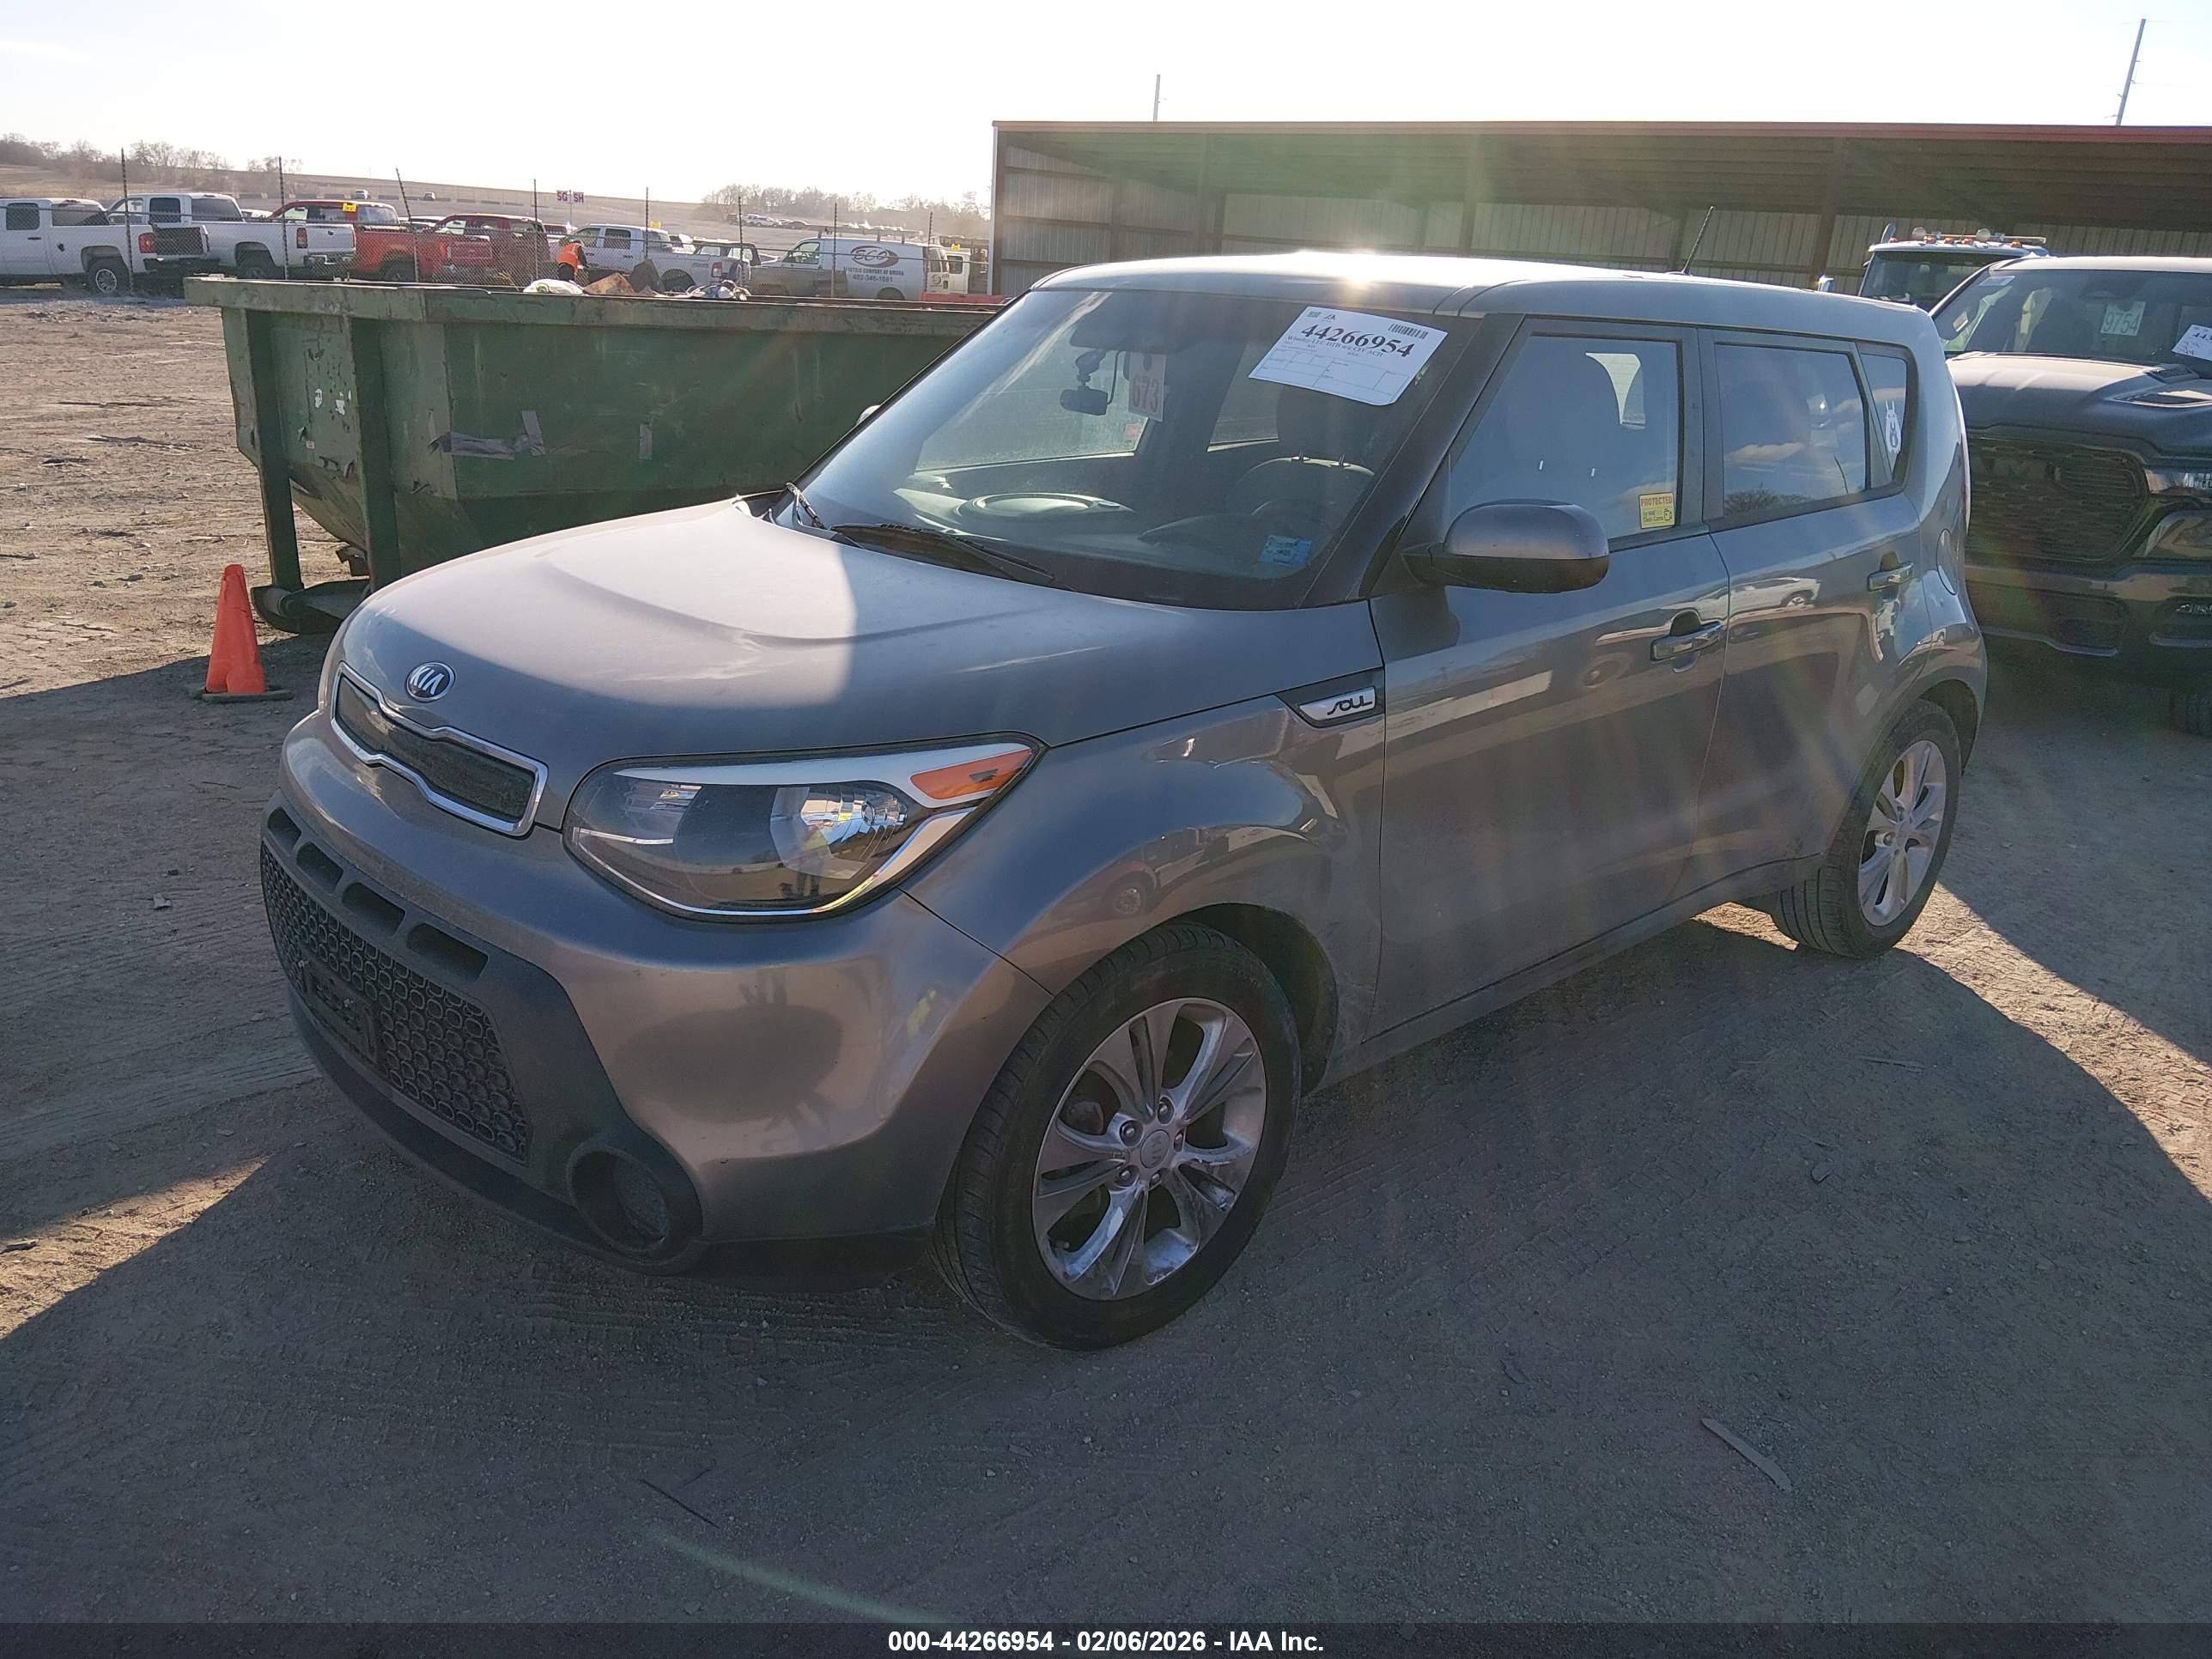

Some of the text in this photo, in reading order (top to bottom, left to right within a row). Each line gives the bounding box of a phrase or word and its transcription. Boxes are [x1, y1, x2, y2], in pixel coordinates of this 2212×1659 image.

[556, 191, 568, 202] SG
[573, 192, 584, 204] SH
[1300, 324, 1415, 357] 44266954
